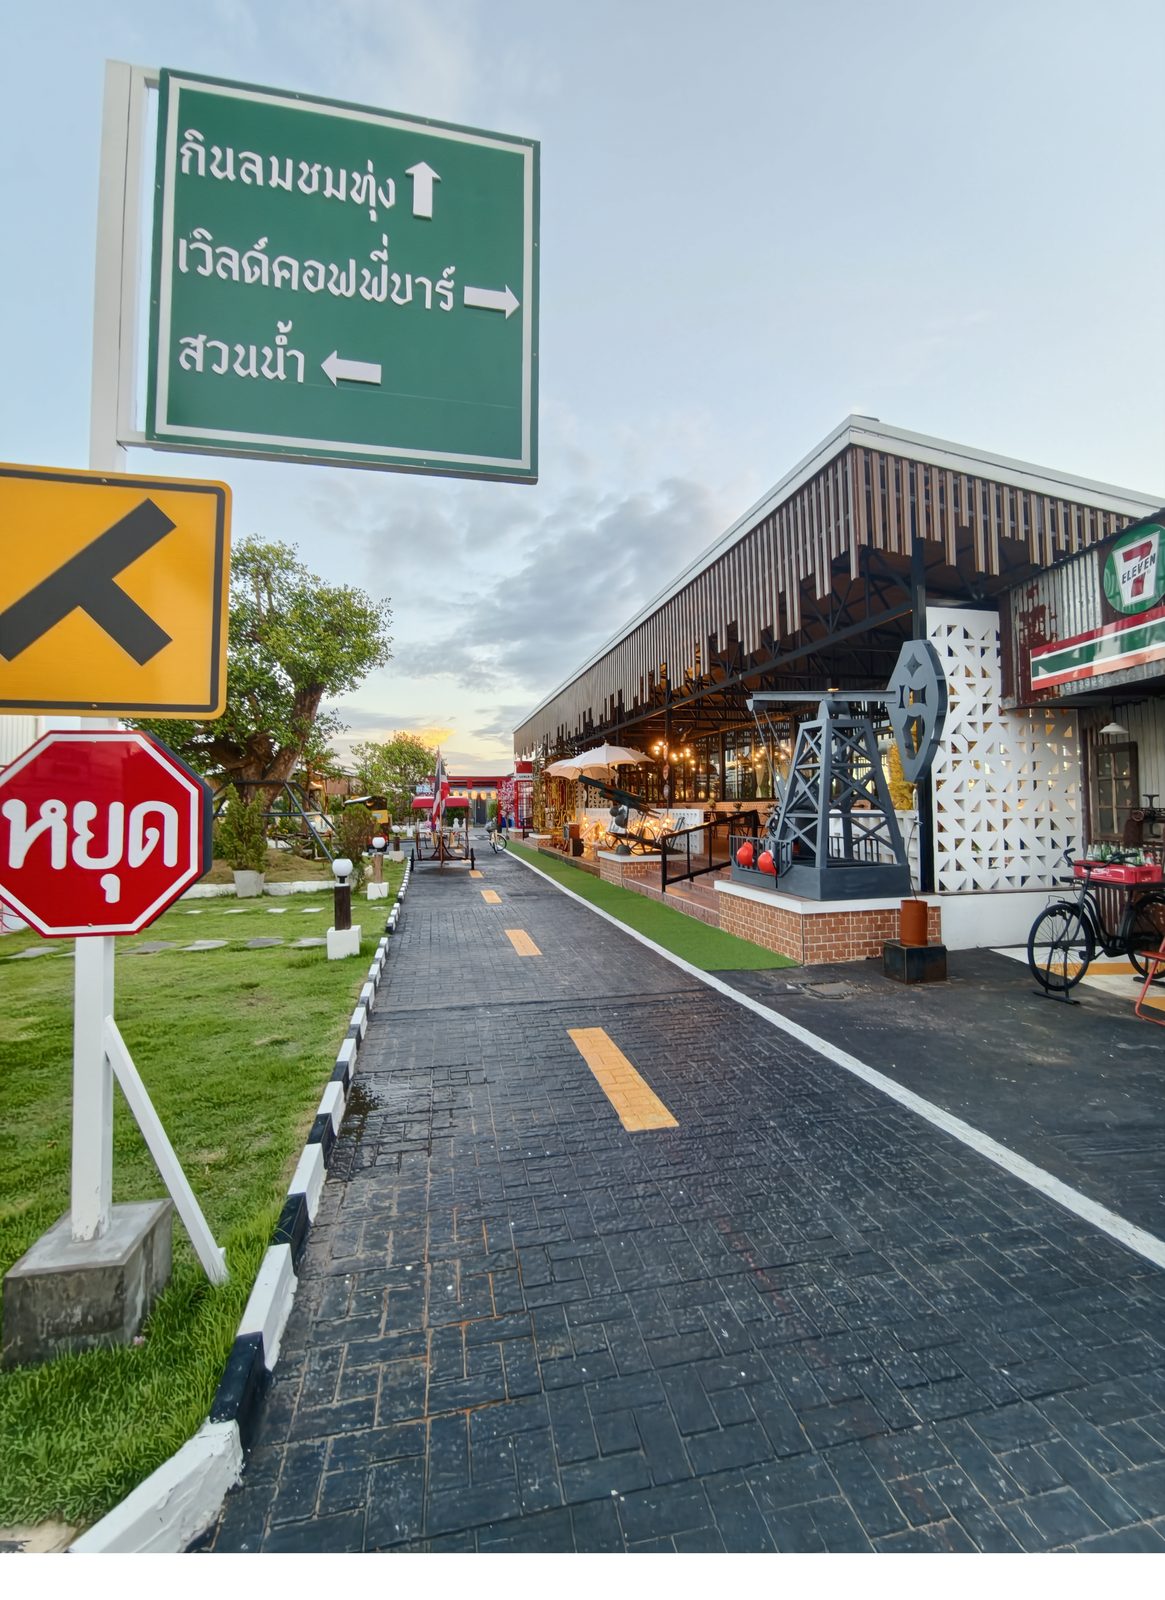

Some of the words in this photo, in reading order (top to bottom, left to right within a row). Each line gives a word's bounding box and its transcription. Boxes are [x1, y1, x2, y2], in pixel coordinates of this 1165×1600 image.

[180, 128, 396, 222] กินลมชมทุ่ง
[178, 227, 456, 312] เวิลด์คอฟฟี่บาร์
[178, 319, 305, 383] สวนน้ำ
[1121, 552, 1156, 585] ELEVEN
[1121, 540, 1153, 599] 7
[1, 798, 179, 904] หยุด
